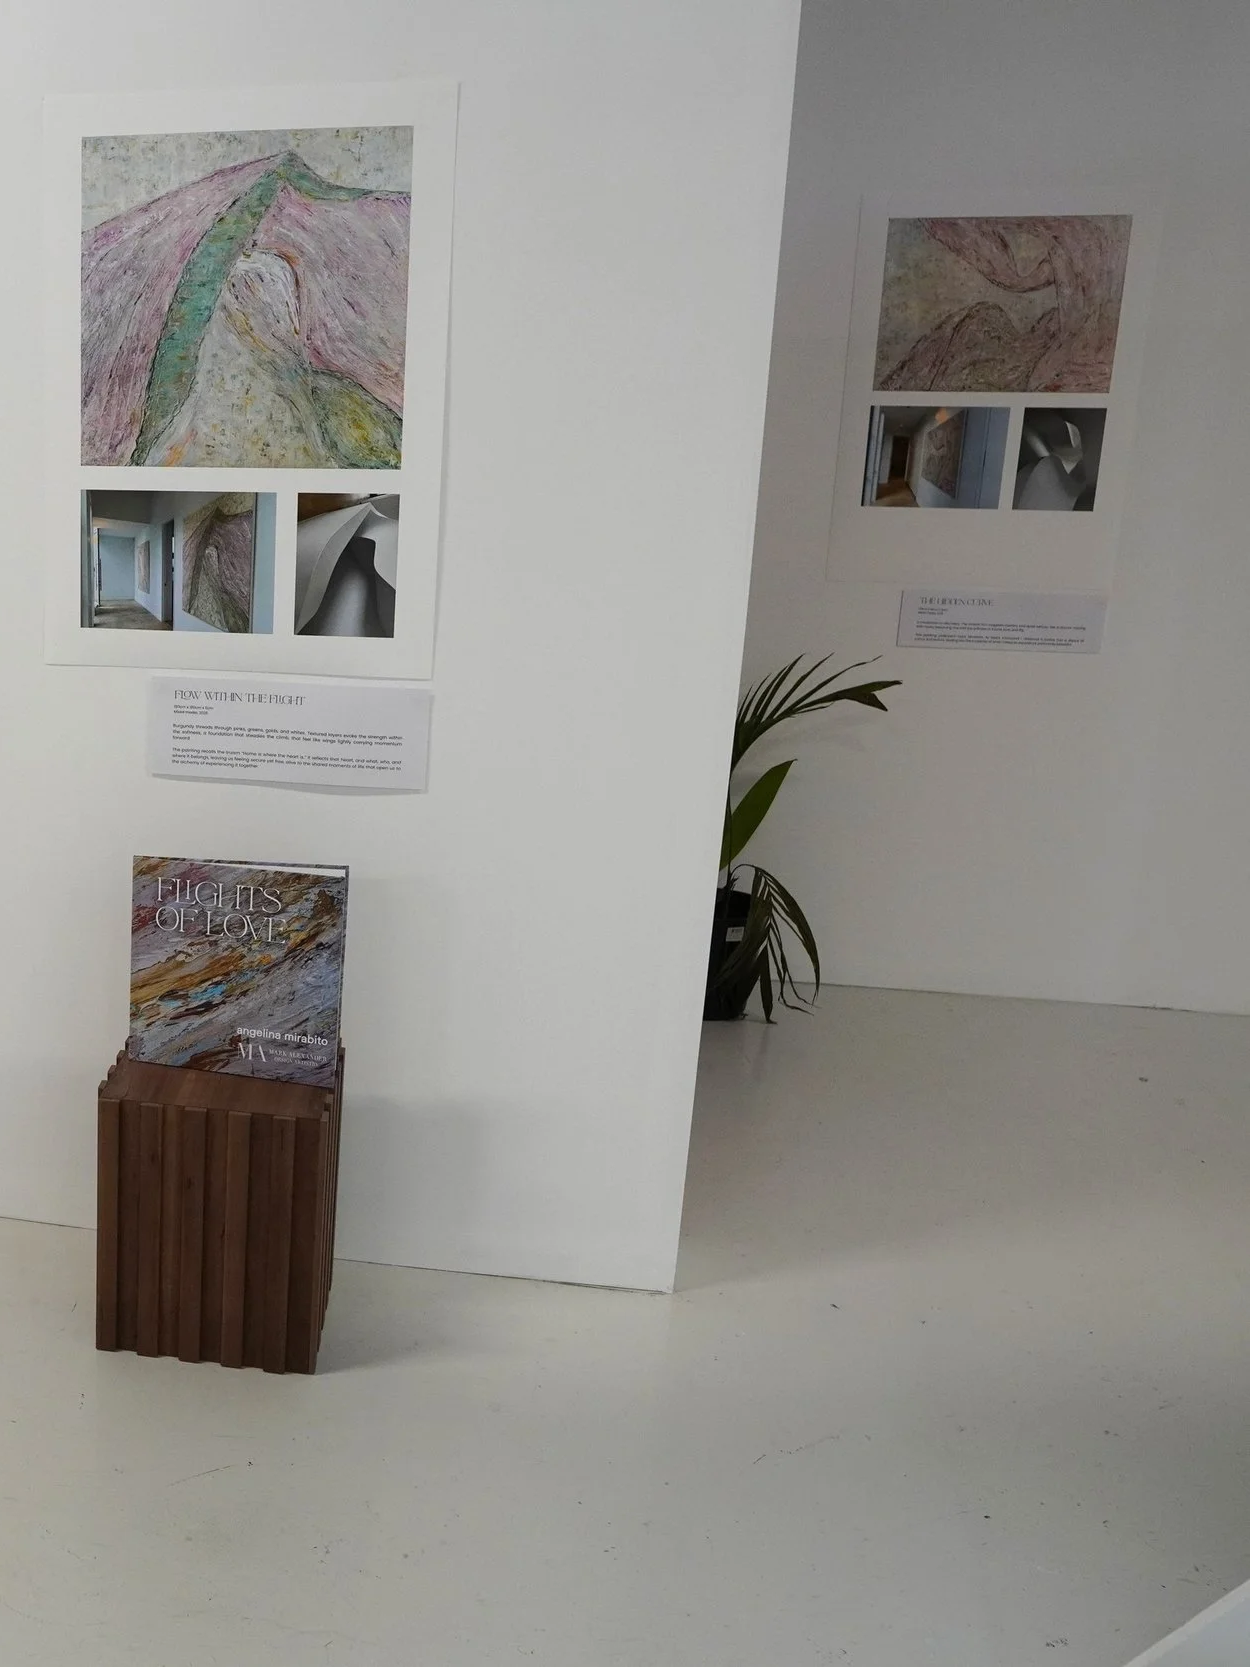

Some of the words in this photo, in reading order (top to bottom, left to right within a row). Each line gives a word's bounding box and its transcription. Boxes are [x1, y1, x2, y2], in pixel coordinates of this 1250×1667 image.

[174, 690, 202, 701] FLOW
[204, 690, 243, 702] WITHIN
[245, 692, 266, 704] THE
[269, 694, 306, 706] FLIGHT
[157, 876, 282, 914] FLIGHTS
[155, 906, 197, 932] OF
[206, 910, 286, 944] LOVE
[236, 1027, 281, 1040] angelina
[284, 1032, 328, 1046] mirabito
[238, 1042, 267, 1062] MA
[269, 1049, 287, 1057] MARK
[289, 1051, 328, 1062] ALEXANDER
